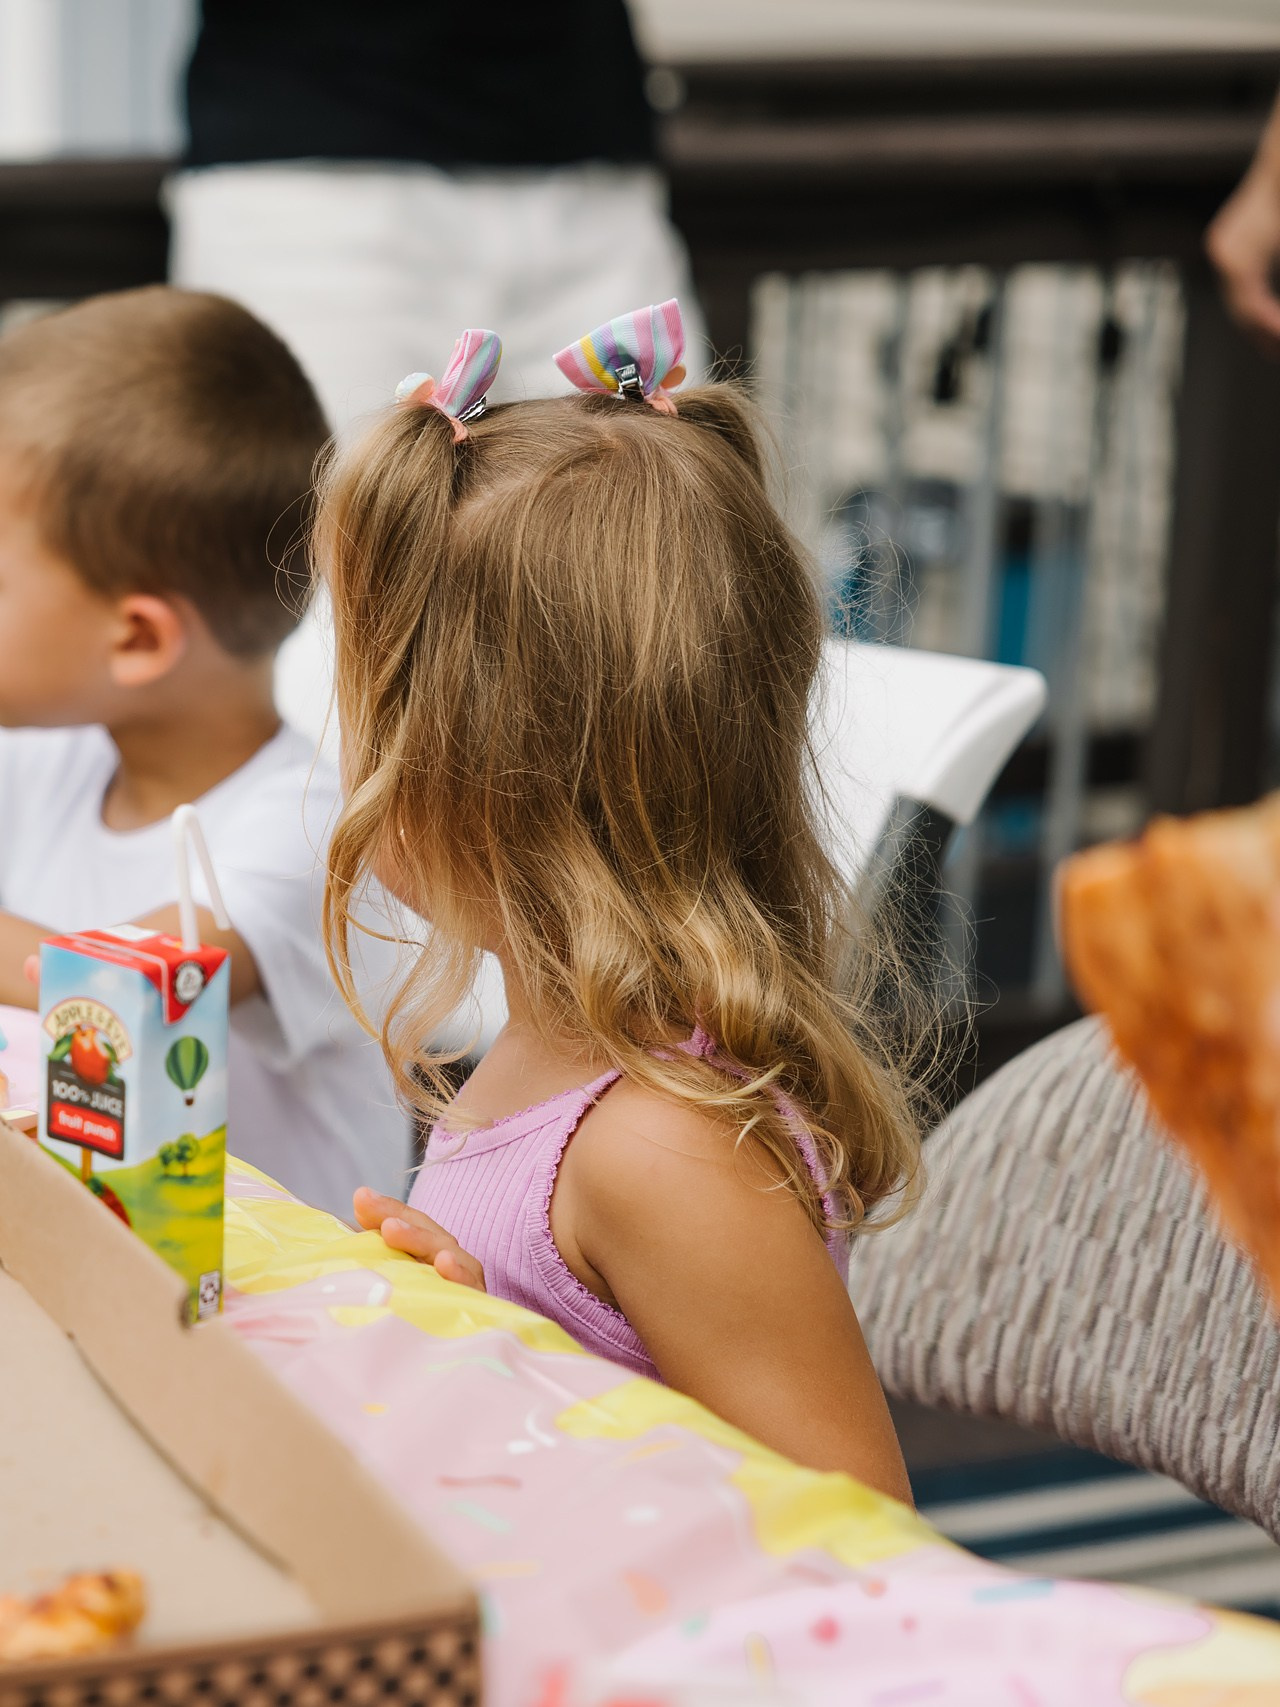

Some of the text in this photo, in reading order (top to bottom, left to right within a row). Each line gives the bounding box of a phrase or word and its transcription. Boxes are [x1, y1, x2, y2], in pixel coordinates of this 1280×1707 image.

[54, 1005, 94, 1028] APPLE
[52, 1080, 123, 1118] 100% JUICE
[58, 1110, 117, 1143] fruit punch
